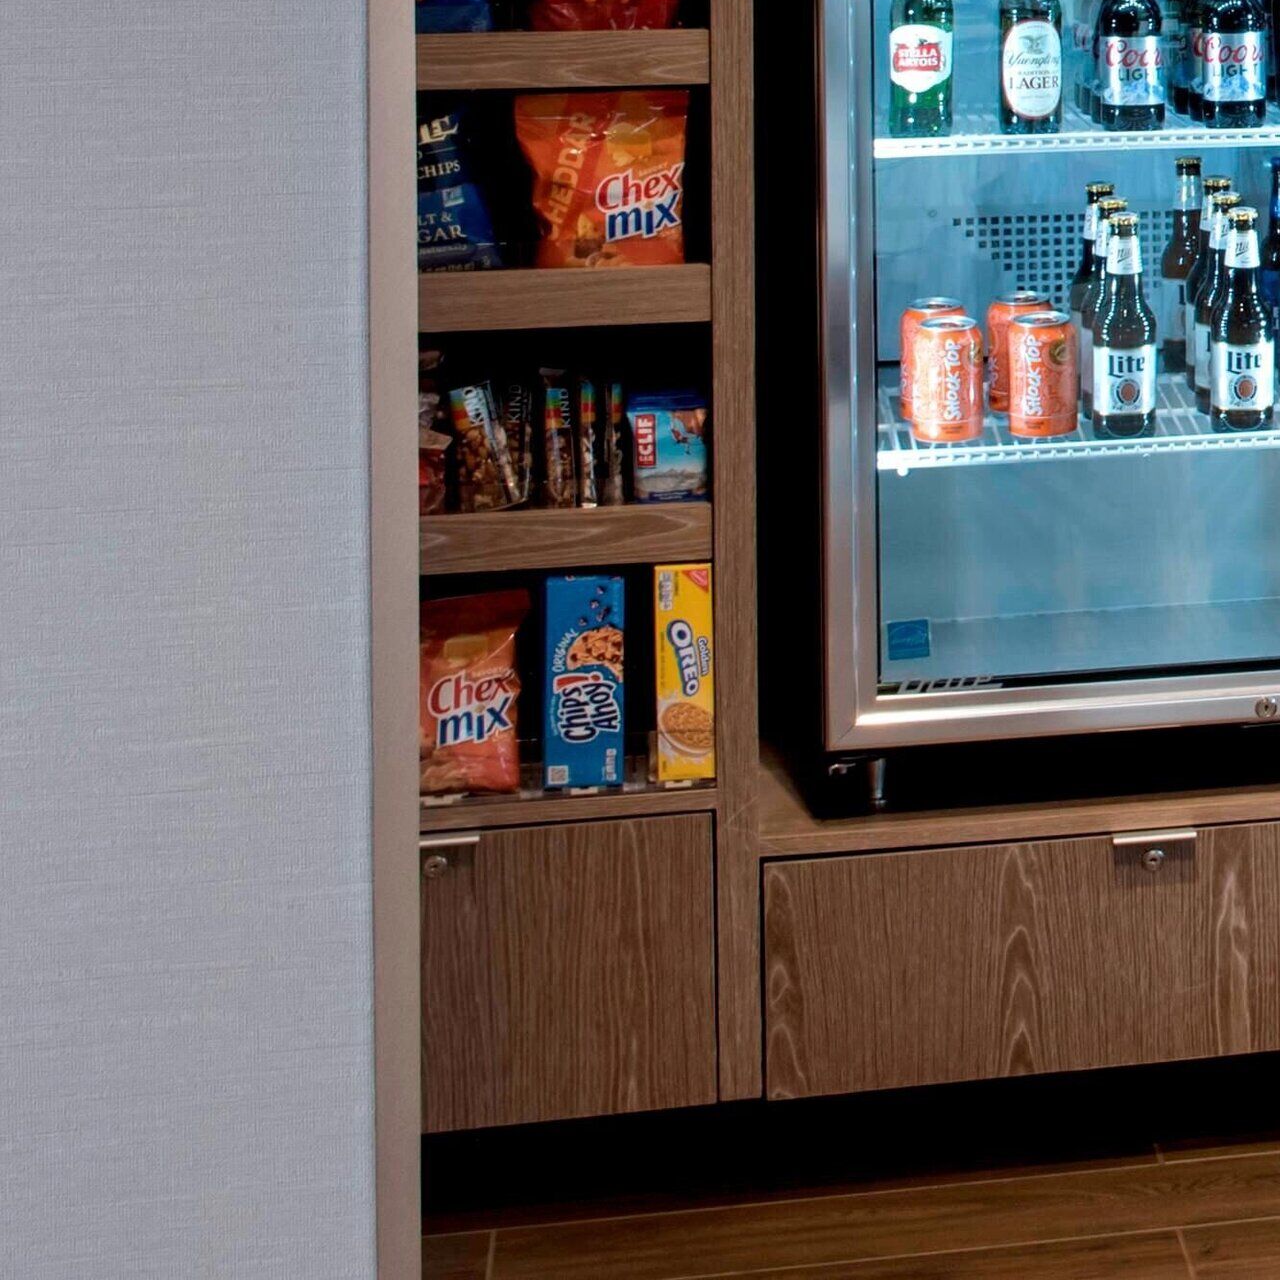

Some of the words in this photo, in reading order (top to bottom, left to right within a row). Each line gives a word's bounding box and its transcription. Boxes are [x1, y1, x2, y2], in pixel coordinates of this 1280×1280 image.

[897, 48, 938, 58] STELLA
[597, 163, 684, 212] Chex
[606, 192, 682, 242] mix
[943, 341, 961, 367] TOP
[1023, 334, 1042, 363] TOP
[1108, 354, 1145, 379] Lite
[1226, 351, 1262, 375] Lite
[462, 385, 486, 427] KIND
[508, 384, 522, 424] KIND
[560, 387, 572, 429] KIND
[1023, 368, 1042, 417] SHOCK
[637, 417, 655, 456] CLIF
[552, 627, 579, 672] ORIGINAL
[668, 620, 700, 697] OREO
[697, 635, 711, 677] Golden
[428, 669, 520, 717] Chex
[437, 695, 518, 748] mix
